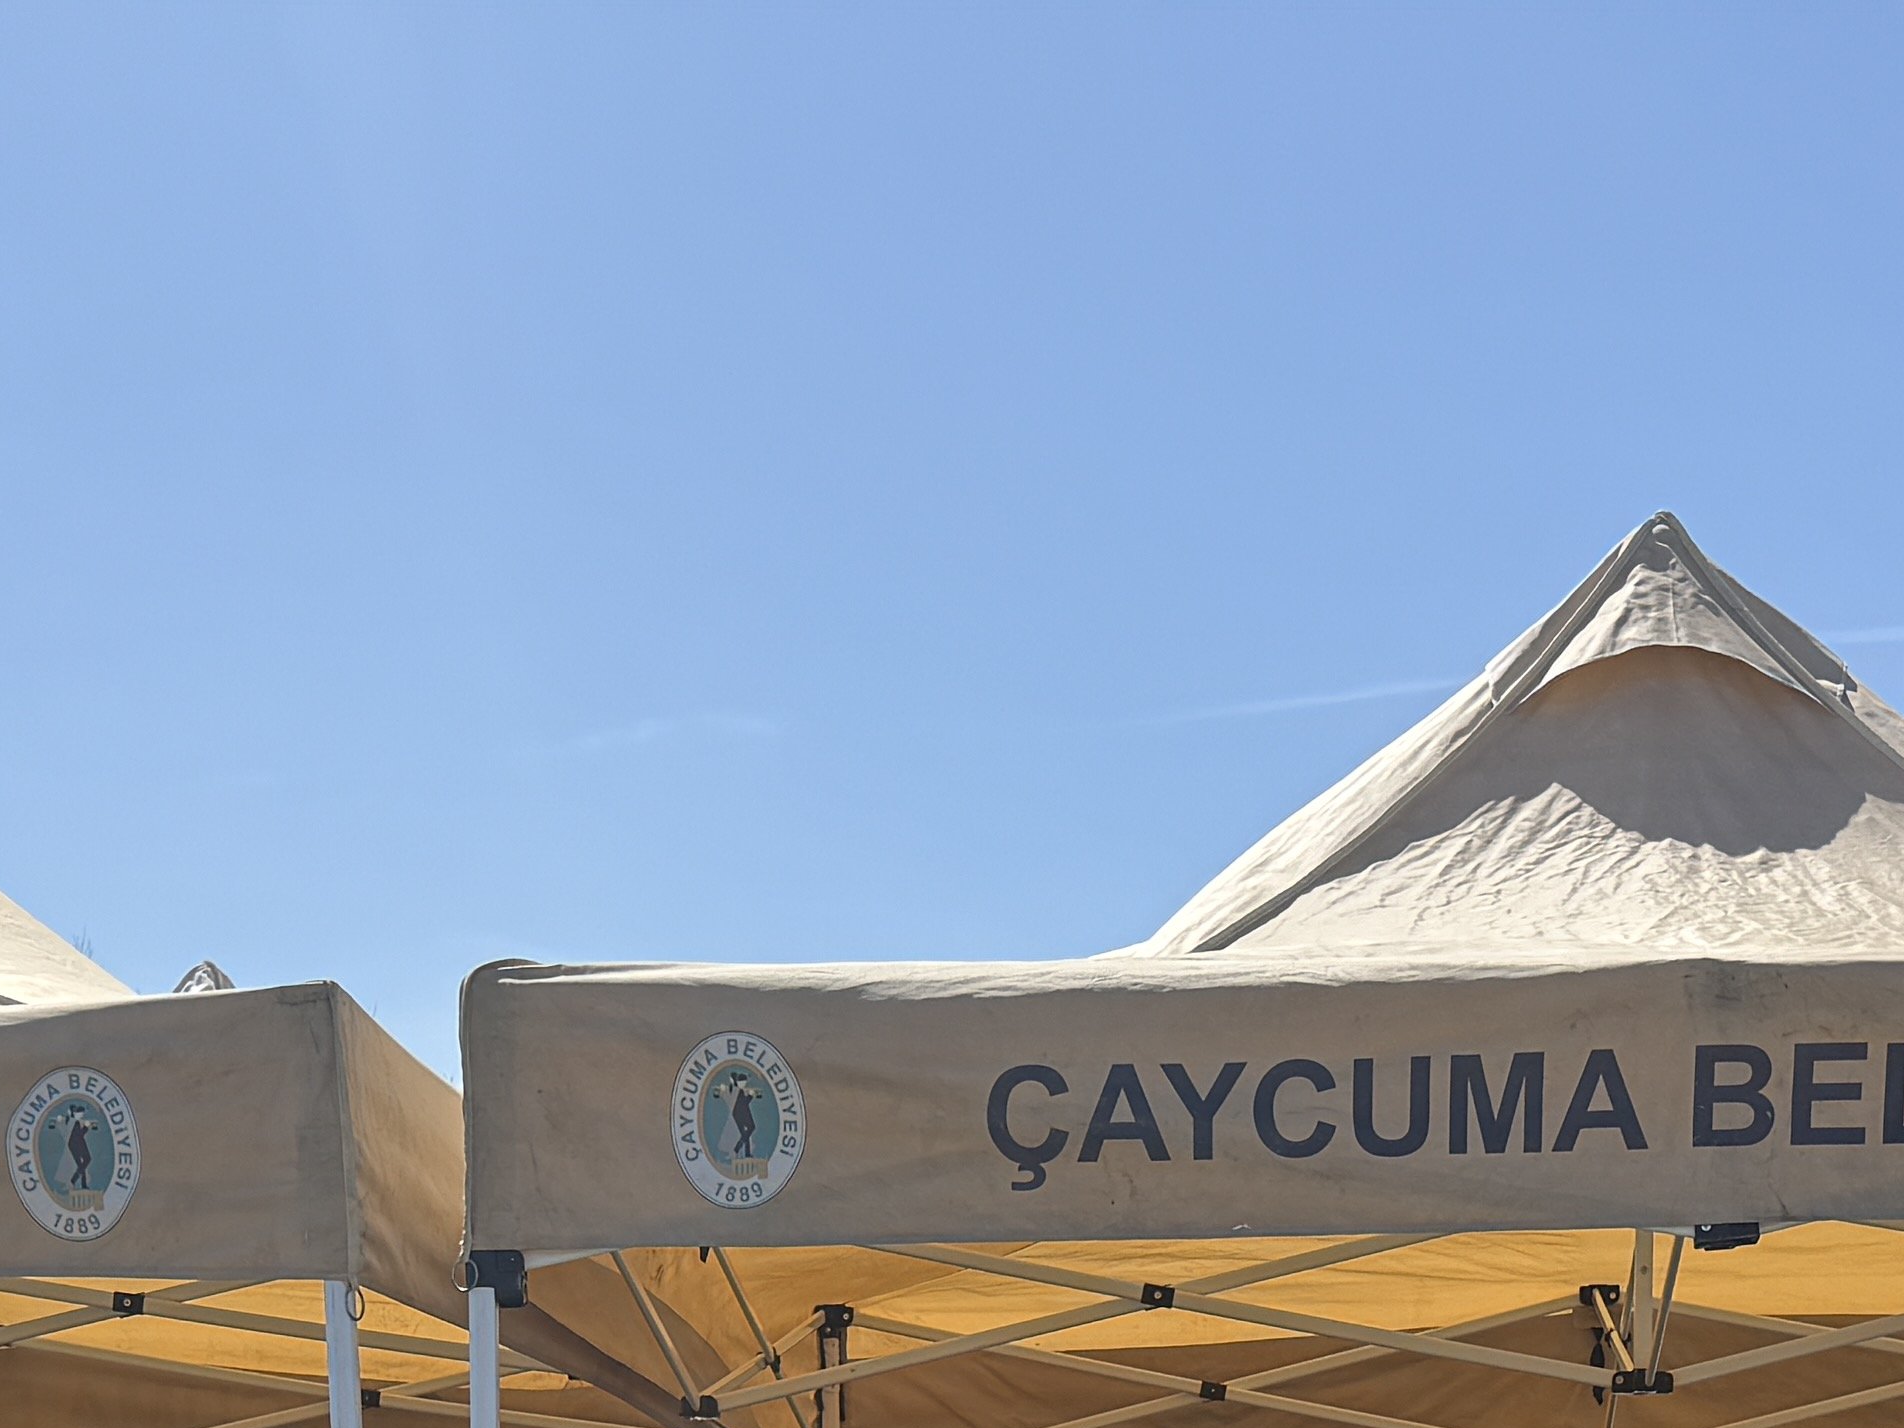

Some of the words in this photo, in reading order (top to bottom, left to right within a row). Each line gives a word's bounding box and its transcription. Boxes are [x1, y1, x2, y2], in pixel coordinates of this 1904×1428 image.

[15, 1082, 61, 1193] ÇAYCUMA
[679, 1048, 719, 1162] ÇAYCUMA
[726, 1038, 798, 1158] BELEDİYESİ
[986, 1048, 1649, 1191] ÇAYCUMA
[53, 1212, 101, 1235] 1889
[714, 1181, 764, 1203] 1889
